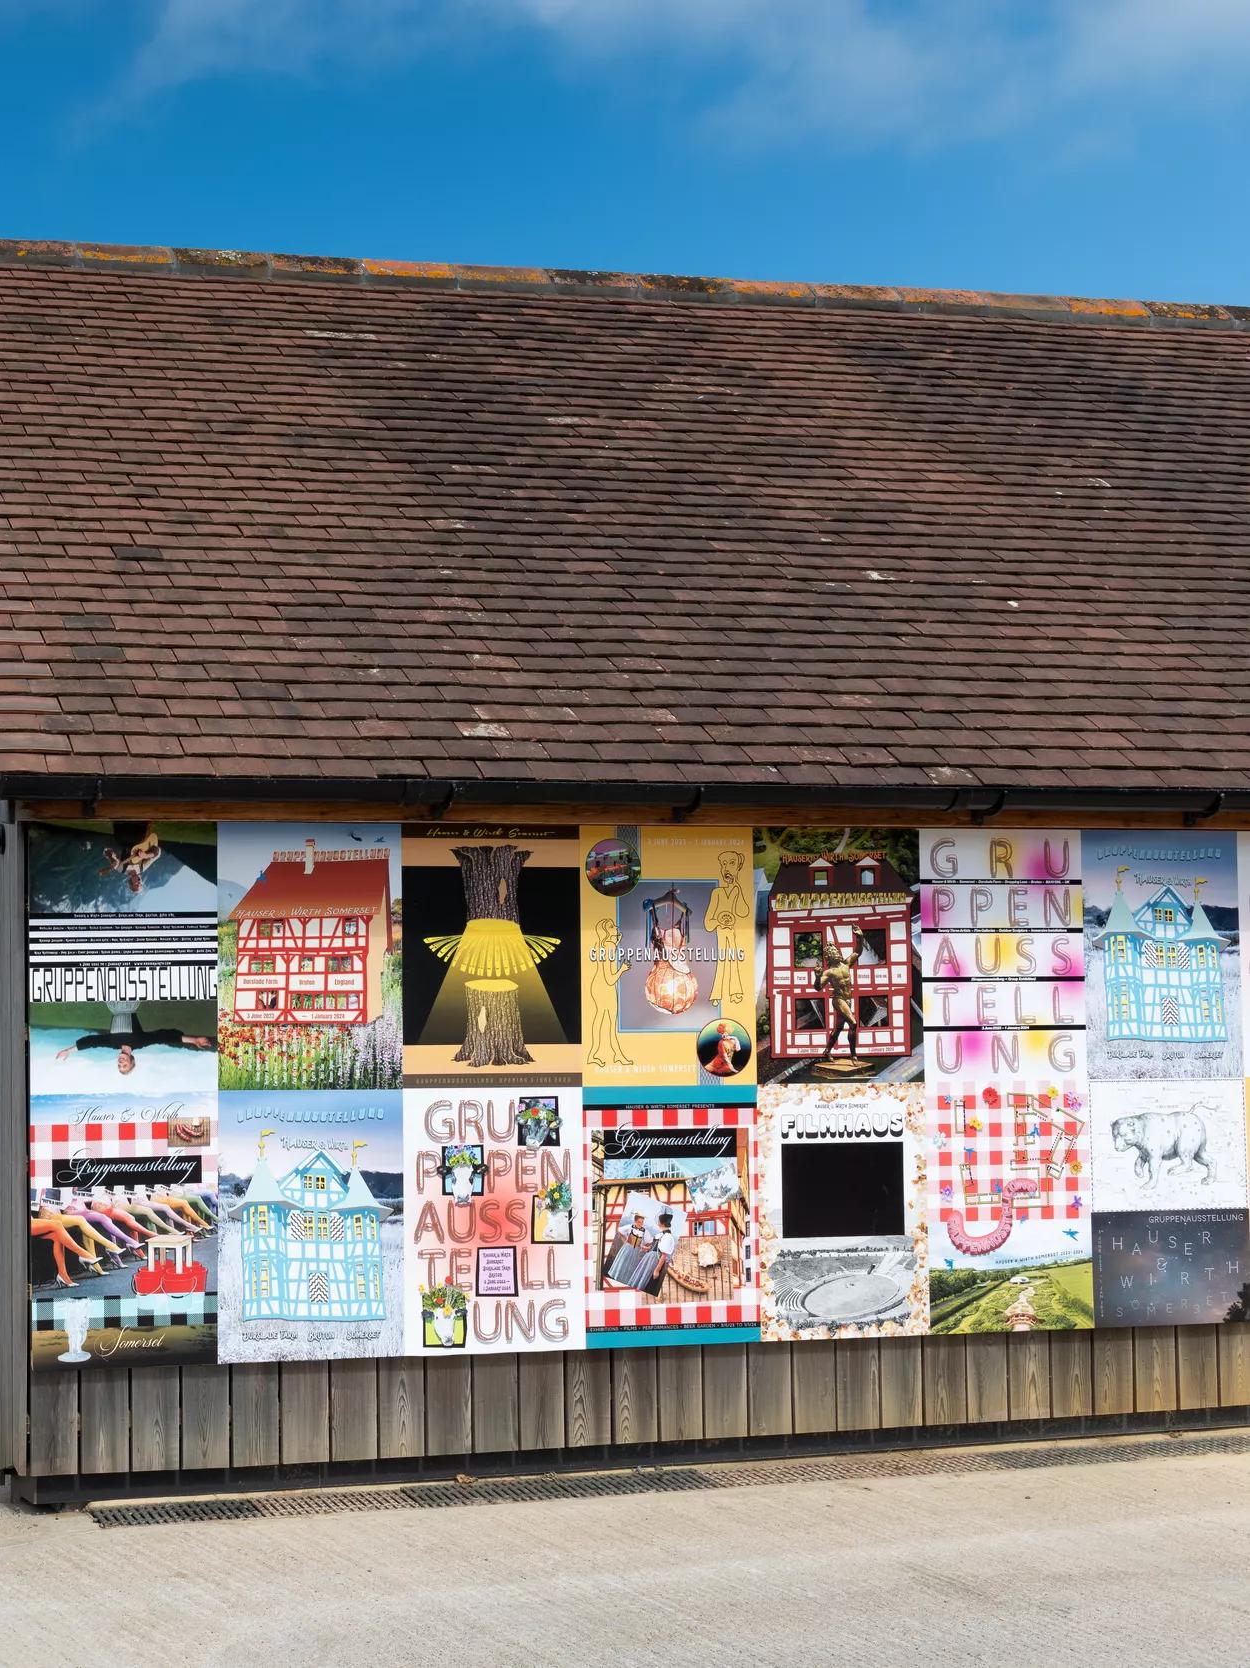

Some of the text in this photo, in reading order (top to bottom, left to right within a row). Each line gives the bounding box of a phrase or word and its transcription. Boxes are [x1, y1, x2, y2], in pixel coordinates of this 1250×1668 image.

[930, 837, 1070, 879] GRU
[235, 909, 277, 918] HAUSER
[291, 906, 321, 916] WIRTH
[324, 906, 378, 916] SOMERSET
[932, 885, 1071, 928] PPEN
[589, 947, 745, 962] GRUPPENAUSSTELLUNG
[932, 935, 1072, 976] AUSS
[32, 966, 218, 1001] GRUPPENAUSSTELLUNG
[334, 978, 354, 986] England
[933, 985, 1075, 1026] TELL
[936, 1032, 1076, 1074] UNG
[72, 1100, 185, 1125] Hauser & Wirth
[424, 1099, 516, 1144] GRU
[781, 1113, 904, 1139] FILMHAUS
[604, 1121, 734, 1159] Gruppenausstellung
[56, 1148, 198, 1188] Gruppenausstellung
[414, 1199, 528, 1245] AUSS
[1148, 1213, 1244, 1224] GRUPPENAUSSTELLUNG
[1112, 1230, 1211, 1256] HAUSER
[1120, 1260, 1239, 1289] WIRTH
[1157, 1257, 1168, 1271] &
[473, 1299, 569, 1345] UNG
[94, 1325, 166, 1359] Somerset
